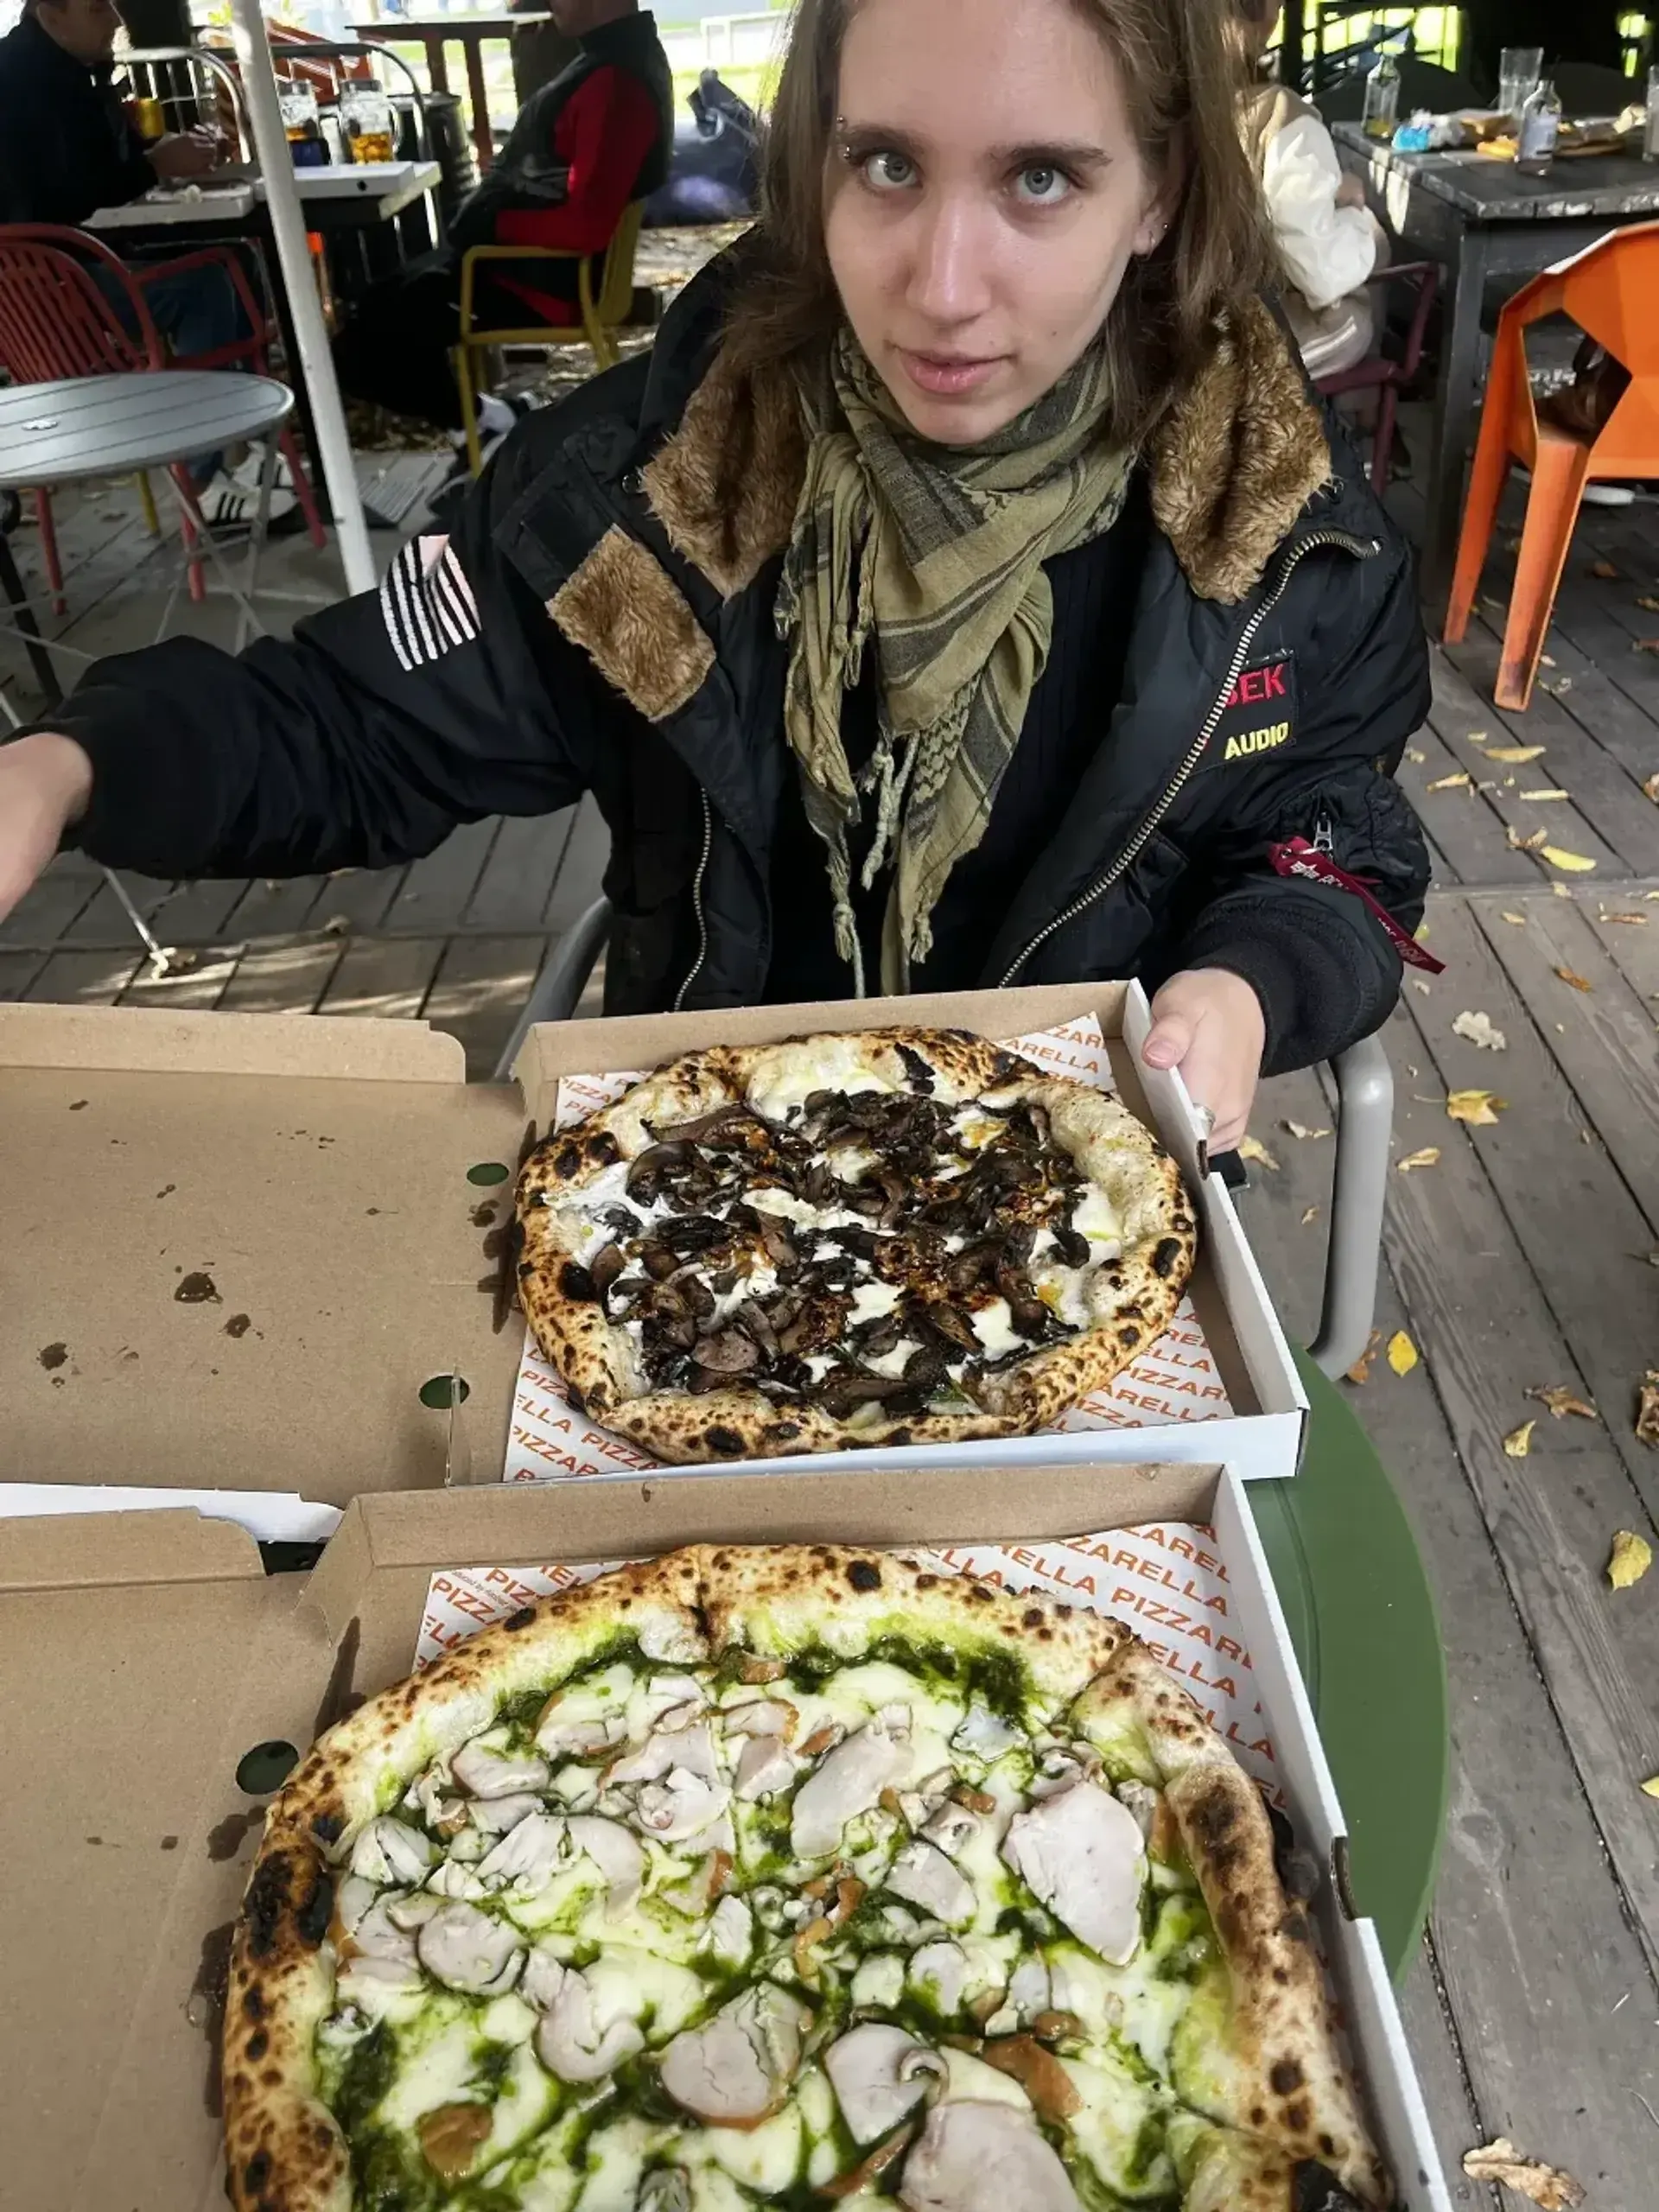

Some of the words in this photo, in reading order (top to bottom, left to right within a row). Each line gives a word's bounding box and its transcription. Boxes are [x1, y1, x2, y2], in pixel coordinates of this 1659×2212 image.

[1224, 721, 1288, 760] AUDIO
[1044, 1025, 1106, 1050] ZAR
[1126, 1364, 1228, 1401] IZZAR
[484, 1567, 544, 1606] PIZ
[928, 1548, 1003, 1587] LLA
[1053, 1537, 1228, 1617] ZARELLA
[1185, 1689, 1275, 1763] LLA
